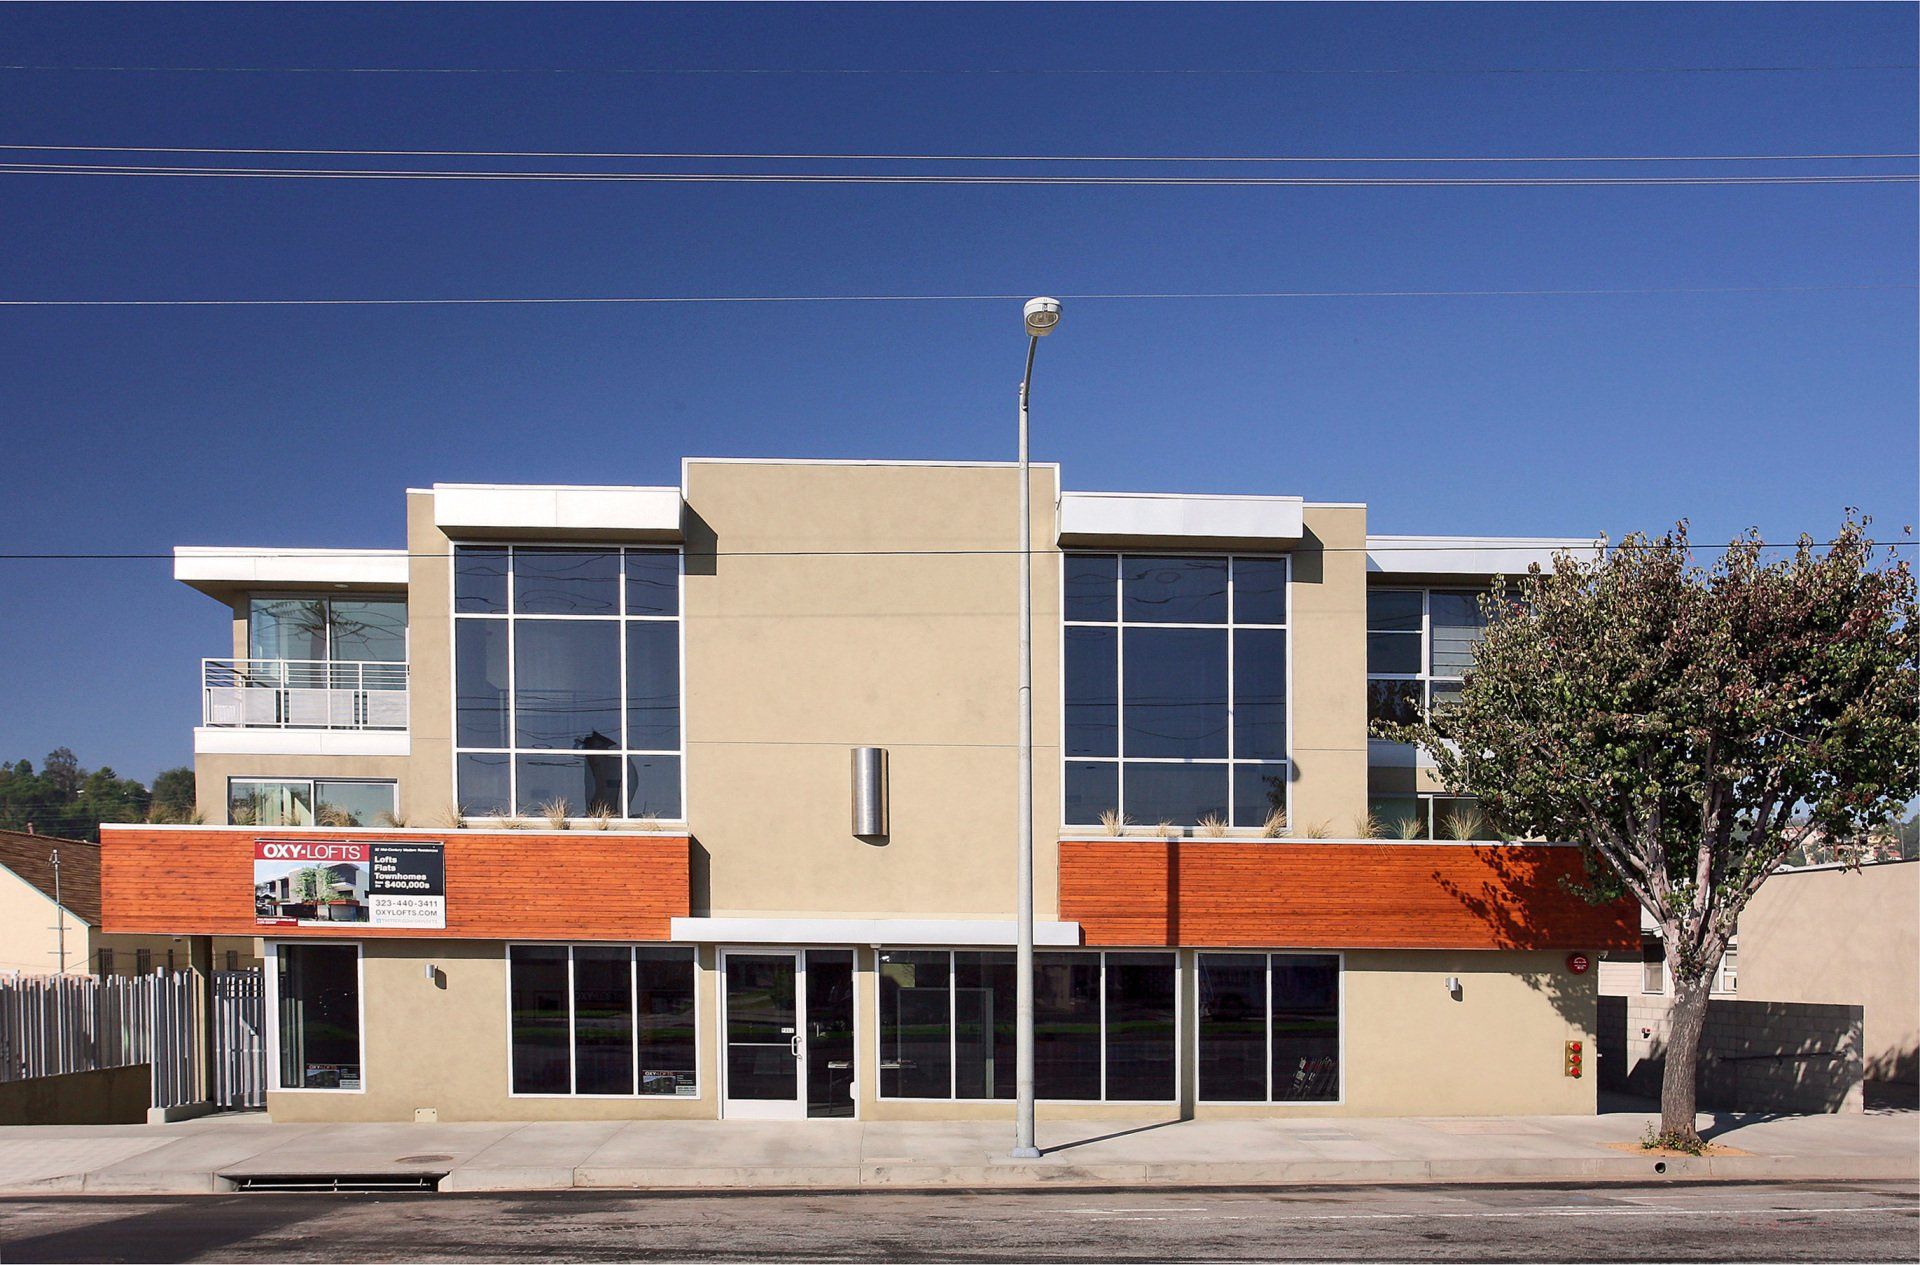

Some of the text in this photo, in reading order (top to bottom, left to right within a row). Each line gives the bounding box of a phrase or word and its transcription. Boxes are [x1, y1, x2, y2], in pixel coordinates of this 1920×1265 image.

[263, 843, 361, 860] OXY-LOFTS
[374, 872, 427, 880] Townhomes
[384, 881, 430, 889] $400,000s
[375, 899, 438, 907] 323-440-3411
